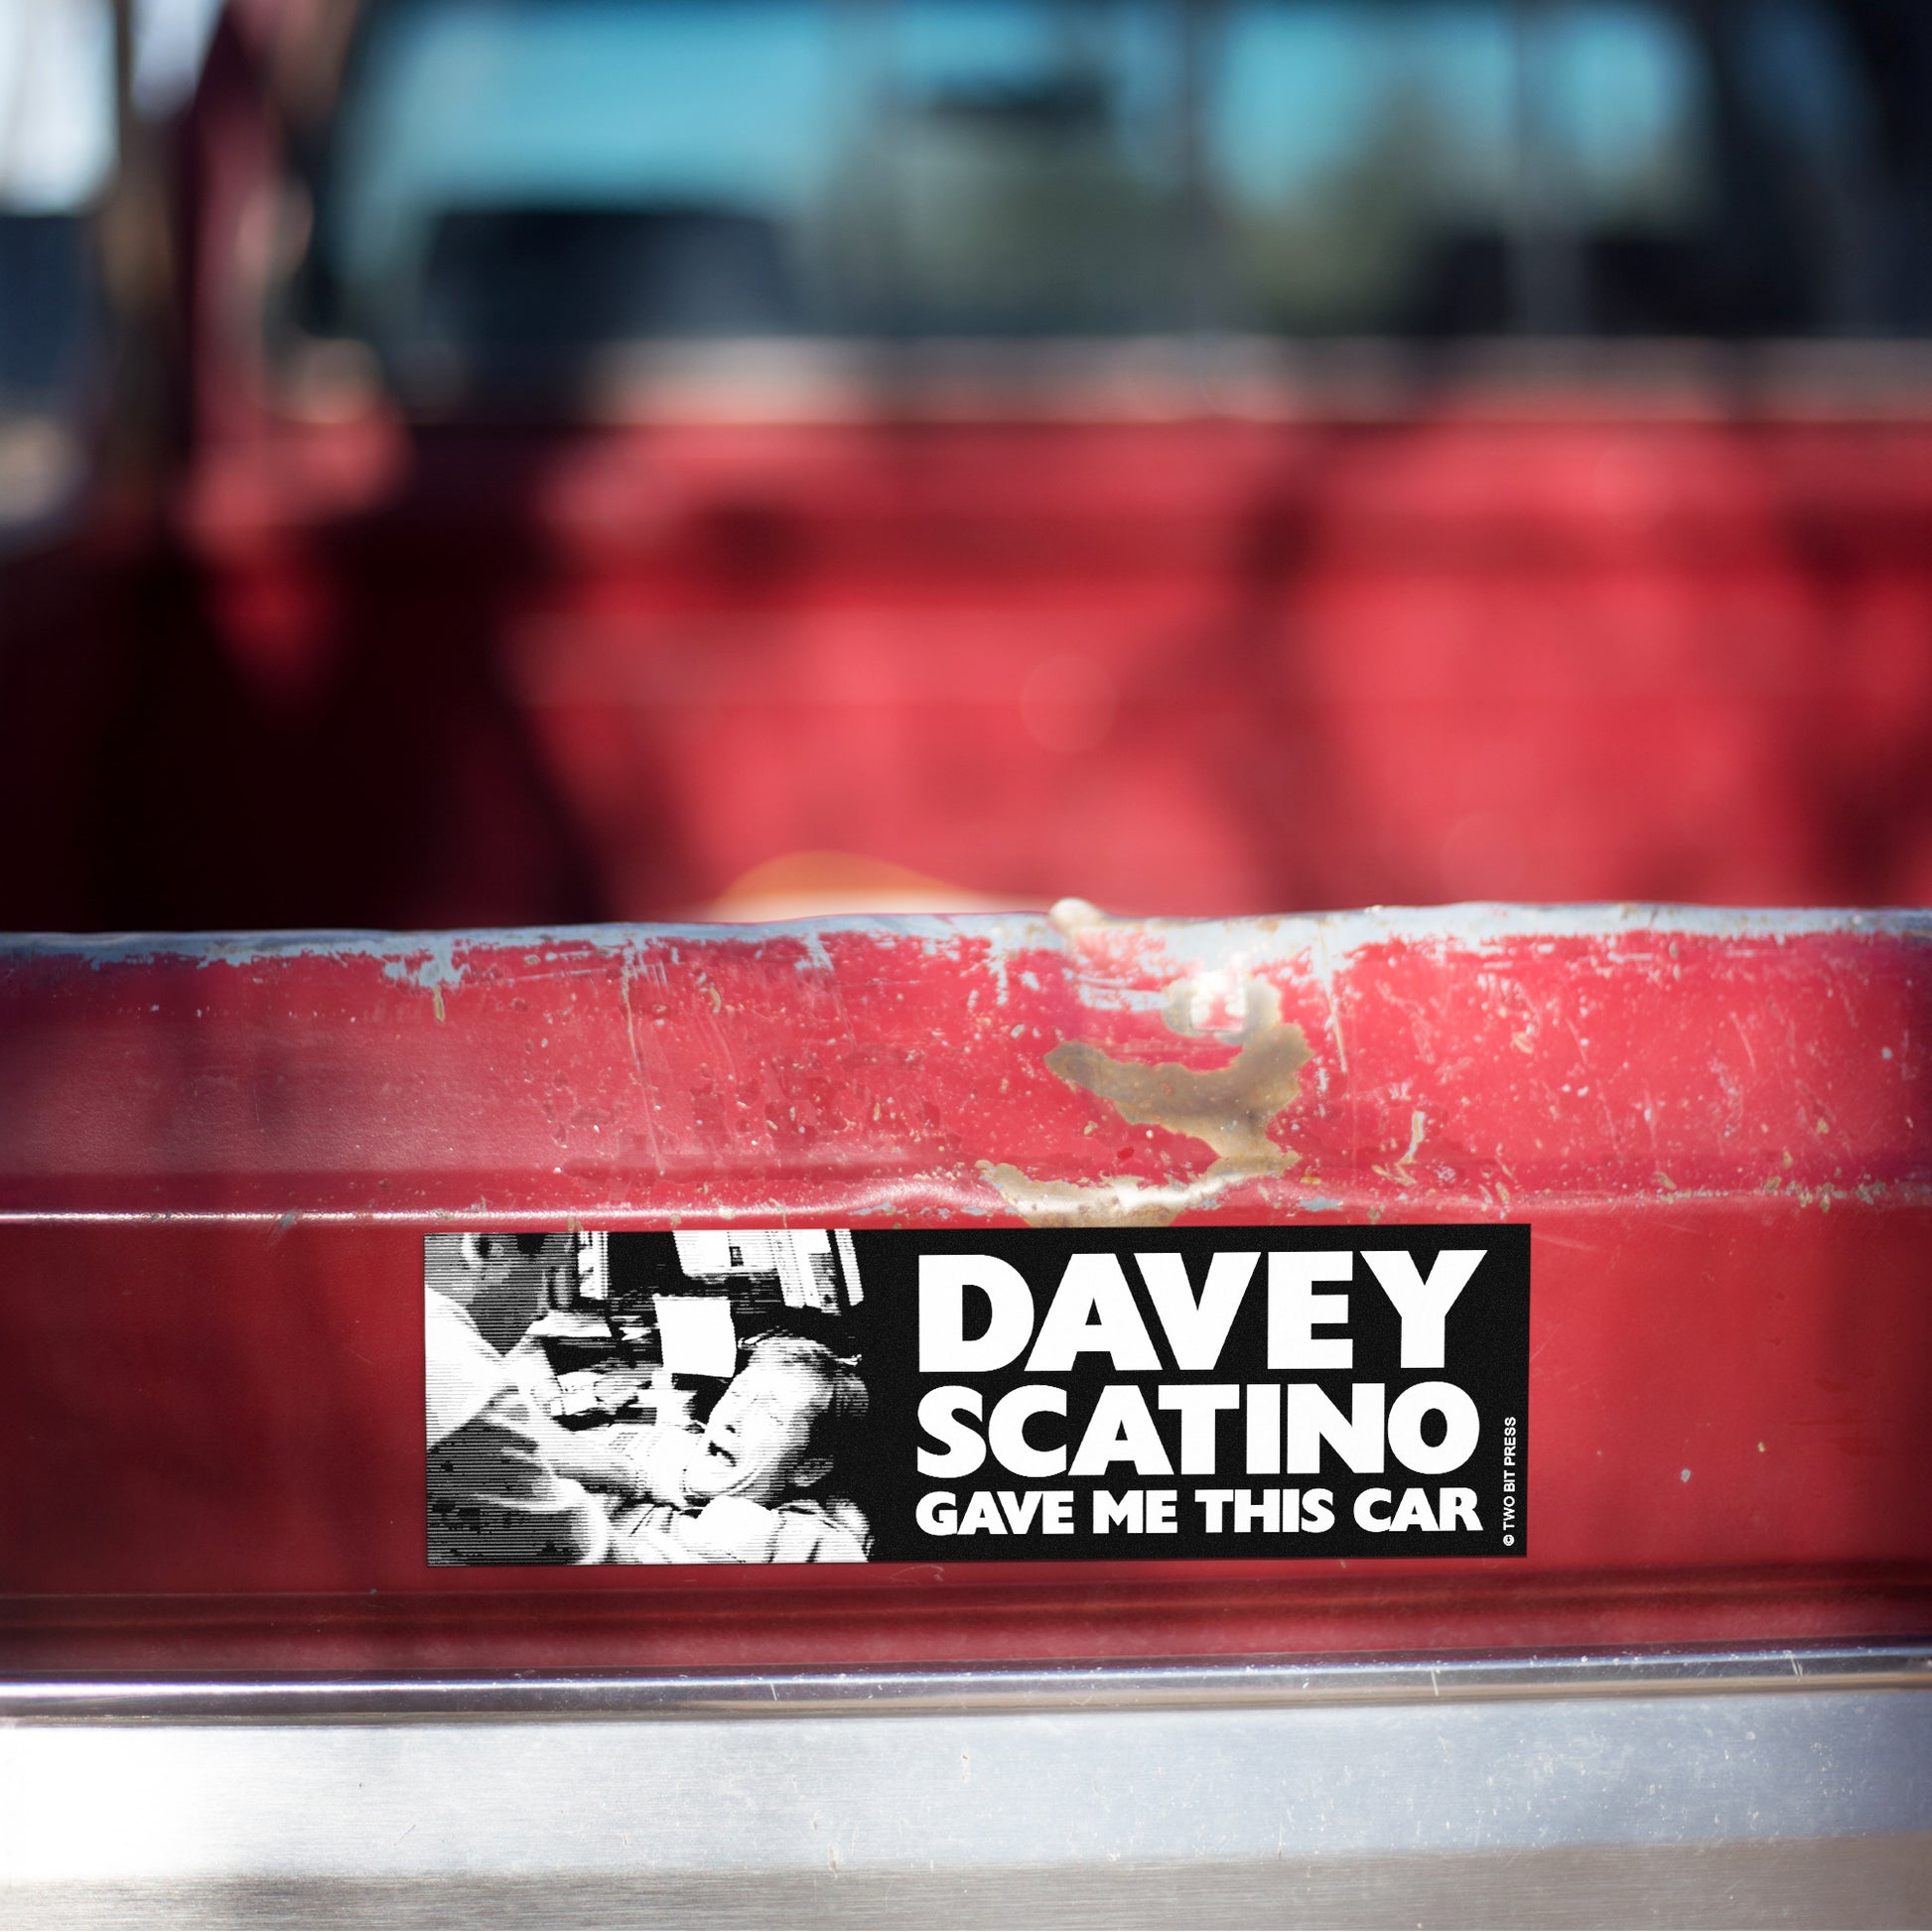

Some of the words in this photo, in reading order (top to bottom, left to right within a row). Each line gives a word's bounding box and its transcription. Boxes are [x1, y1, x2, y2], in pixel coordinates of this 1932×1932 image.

[918, 1249, 1488, 1373] DAVEY
[916, 1381, 1480, 1478] SCATINO
[1503, 1416, 1517, 1466] PRESS
[1503, 1469, 1516, 1492] BIT
[915, 1489, 1075, 1536] GAVE
[1092, 1489, 1178, 1534] ME
[1194, 1487, 1335, 1534] THIS
[1352, 1486, 1484, 1533] CAR
[1502, 1495, 1516, 1531] TWO
